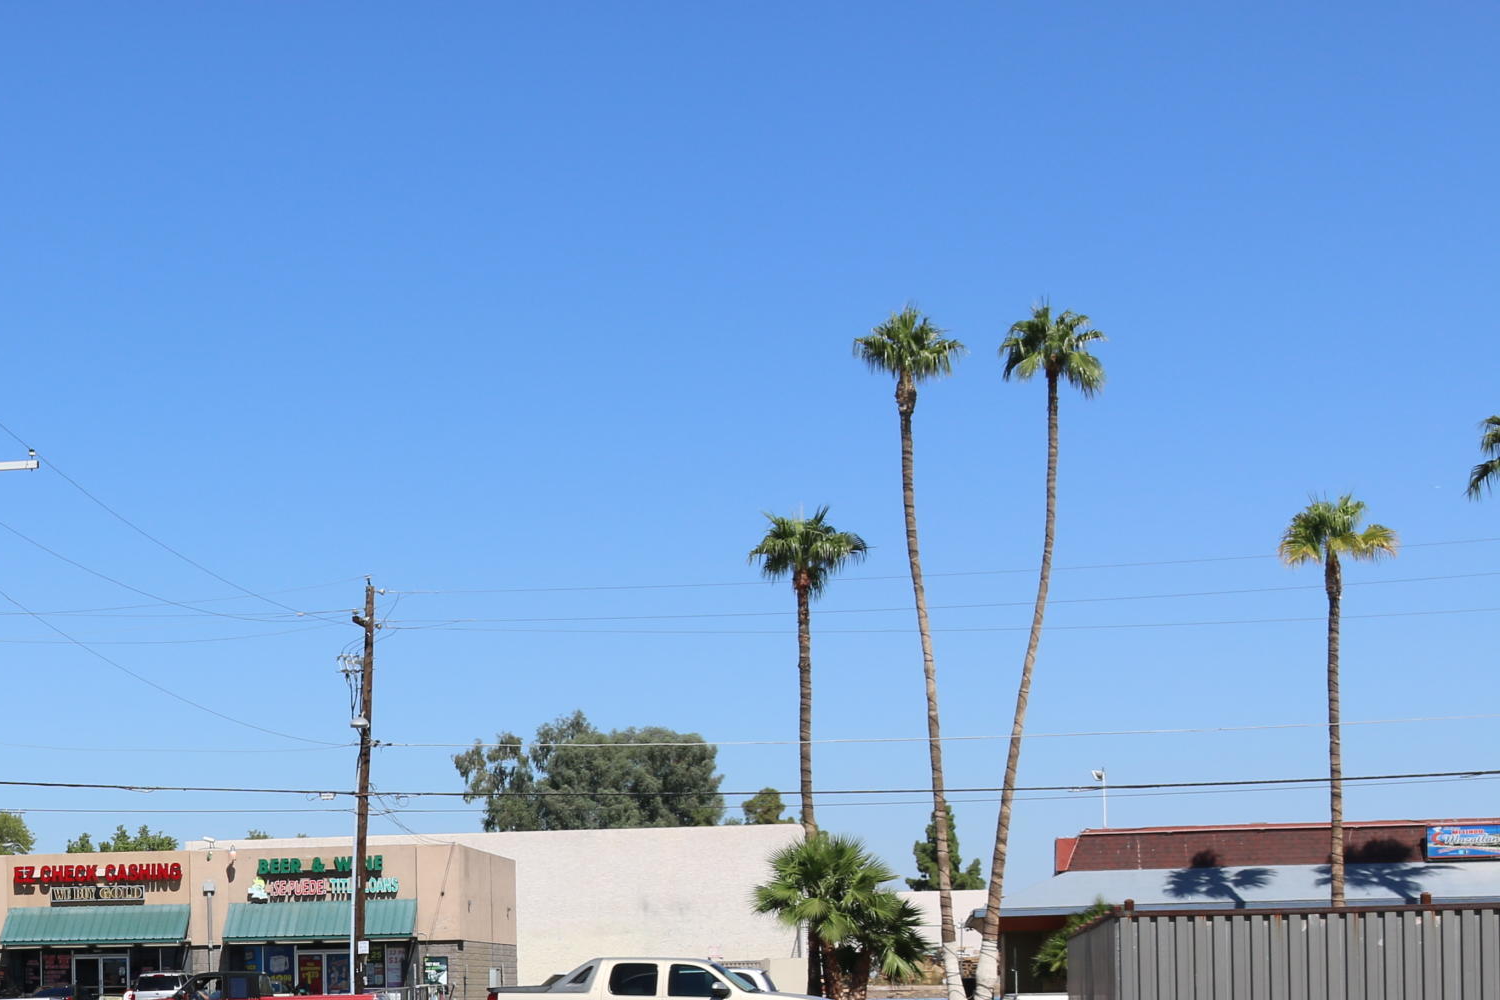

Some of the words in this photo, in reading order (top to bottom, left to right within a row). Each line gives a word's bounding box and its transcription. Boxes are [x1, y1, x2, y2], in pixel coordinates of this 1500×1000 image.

[14, 866, 35, 883] EZ
[40, 864, 98, 883] CHECK
[105, 863, 182, 882] CASHING
[258, 858, 301, 874] BEER
[312, 857, 325, 873] &
[334, 855, 383, 871] WNE
[53, 888, 71, 900] WE
[74, 888, 96, 900] BUY
[99, 886, 142, 900] GOLD
[329, 877, 353, 893] TITL
[365, 876, 400, 893] OANS
